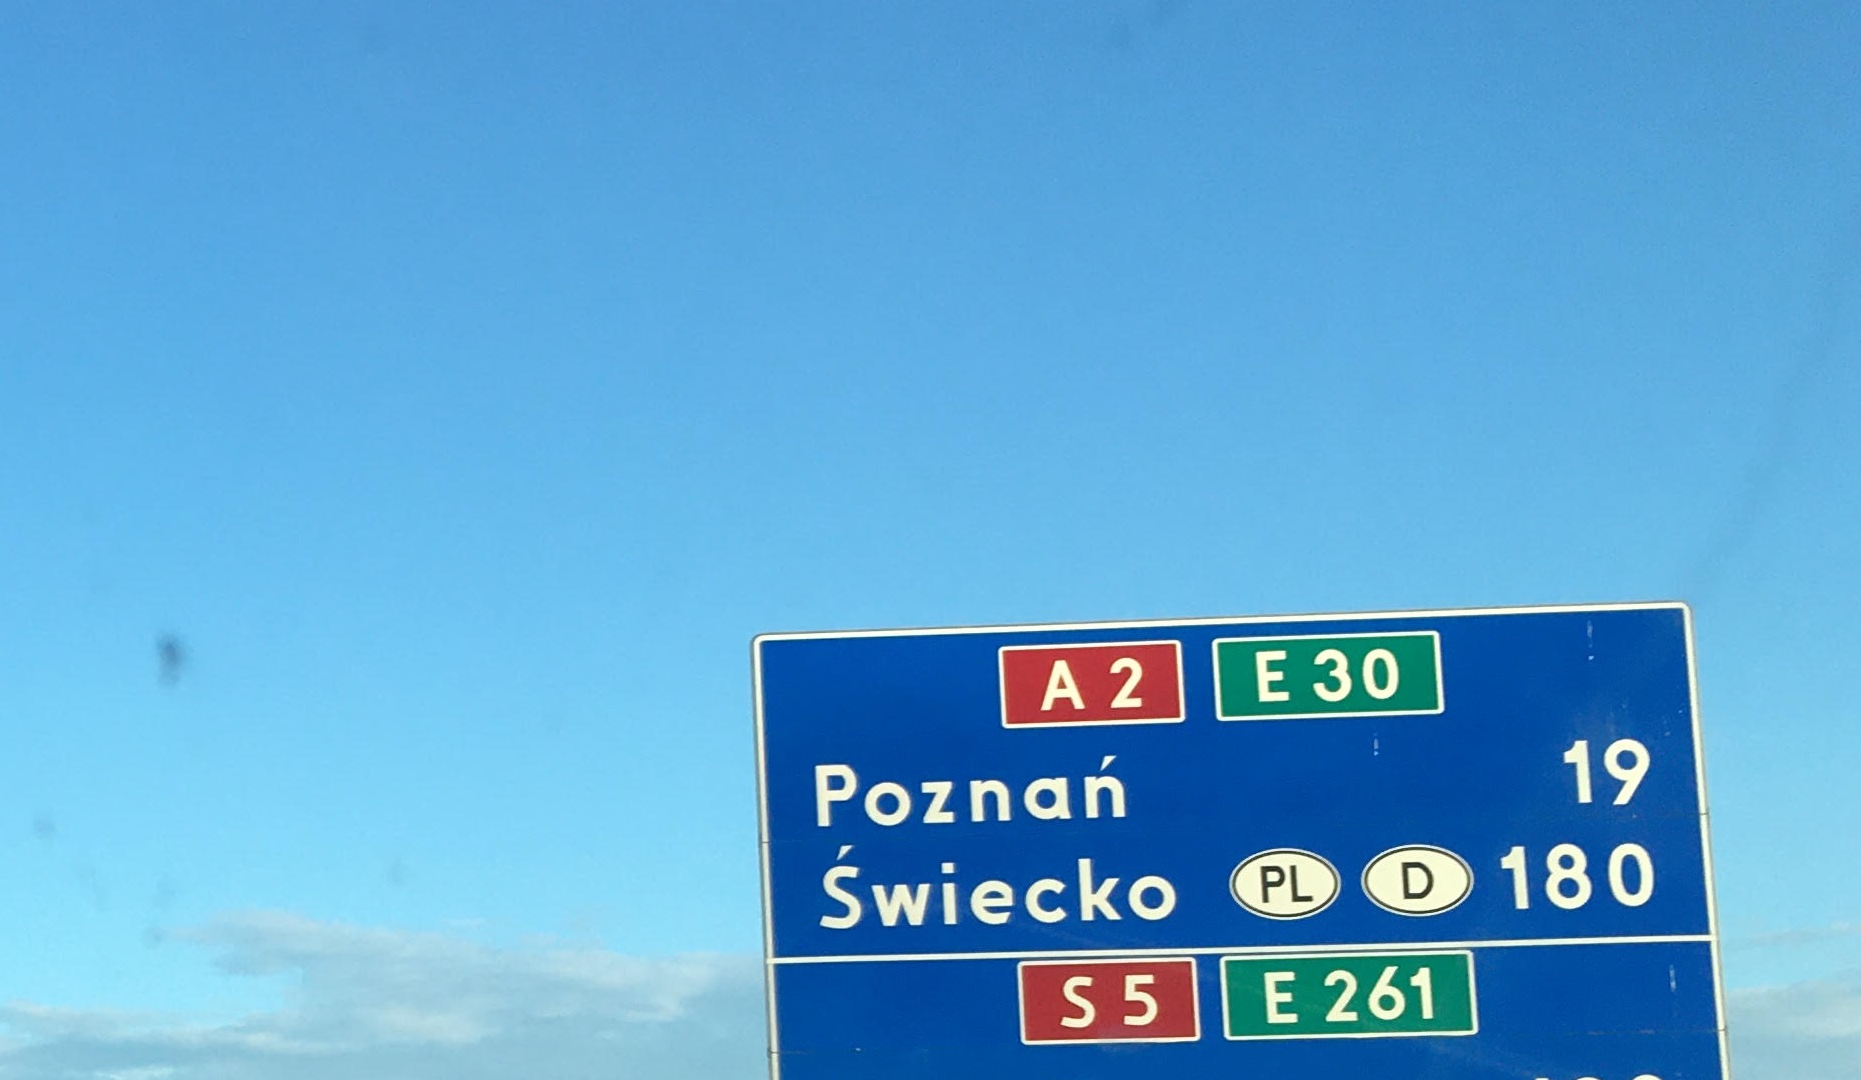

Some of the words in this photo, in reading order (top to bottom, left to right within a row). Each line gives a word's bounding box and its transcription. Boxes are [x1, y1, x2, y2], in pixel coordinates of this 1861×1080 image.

[1040, 659, 1086, 712] A
[1109, 657, 1144, 709] 2
[1254, 650, 1290, 703] E
[1313, 647, 1400, 702] 30
[814, 755, 1127, 828] Poznań
[1562, 738, 1652, 805] 19
[820, 846, 1177, 929] Świecko
[1260, 865, 1314, 904] PL
[1401, 862, 1435, 900] D
[1500, 843, 1655, 911] 180
[1060, 976, 1096, 1029] S
[1124, 973, 1159, 1026] 5
[1264, 971, 1299, 1025] E
[1323, 966, 1435, 1023] 261
